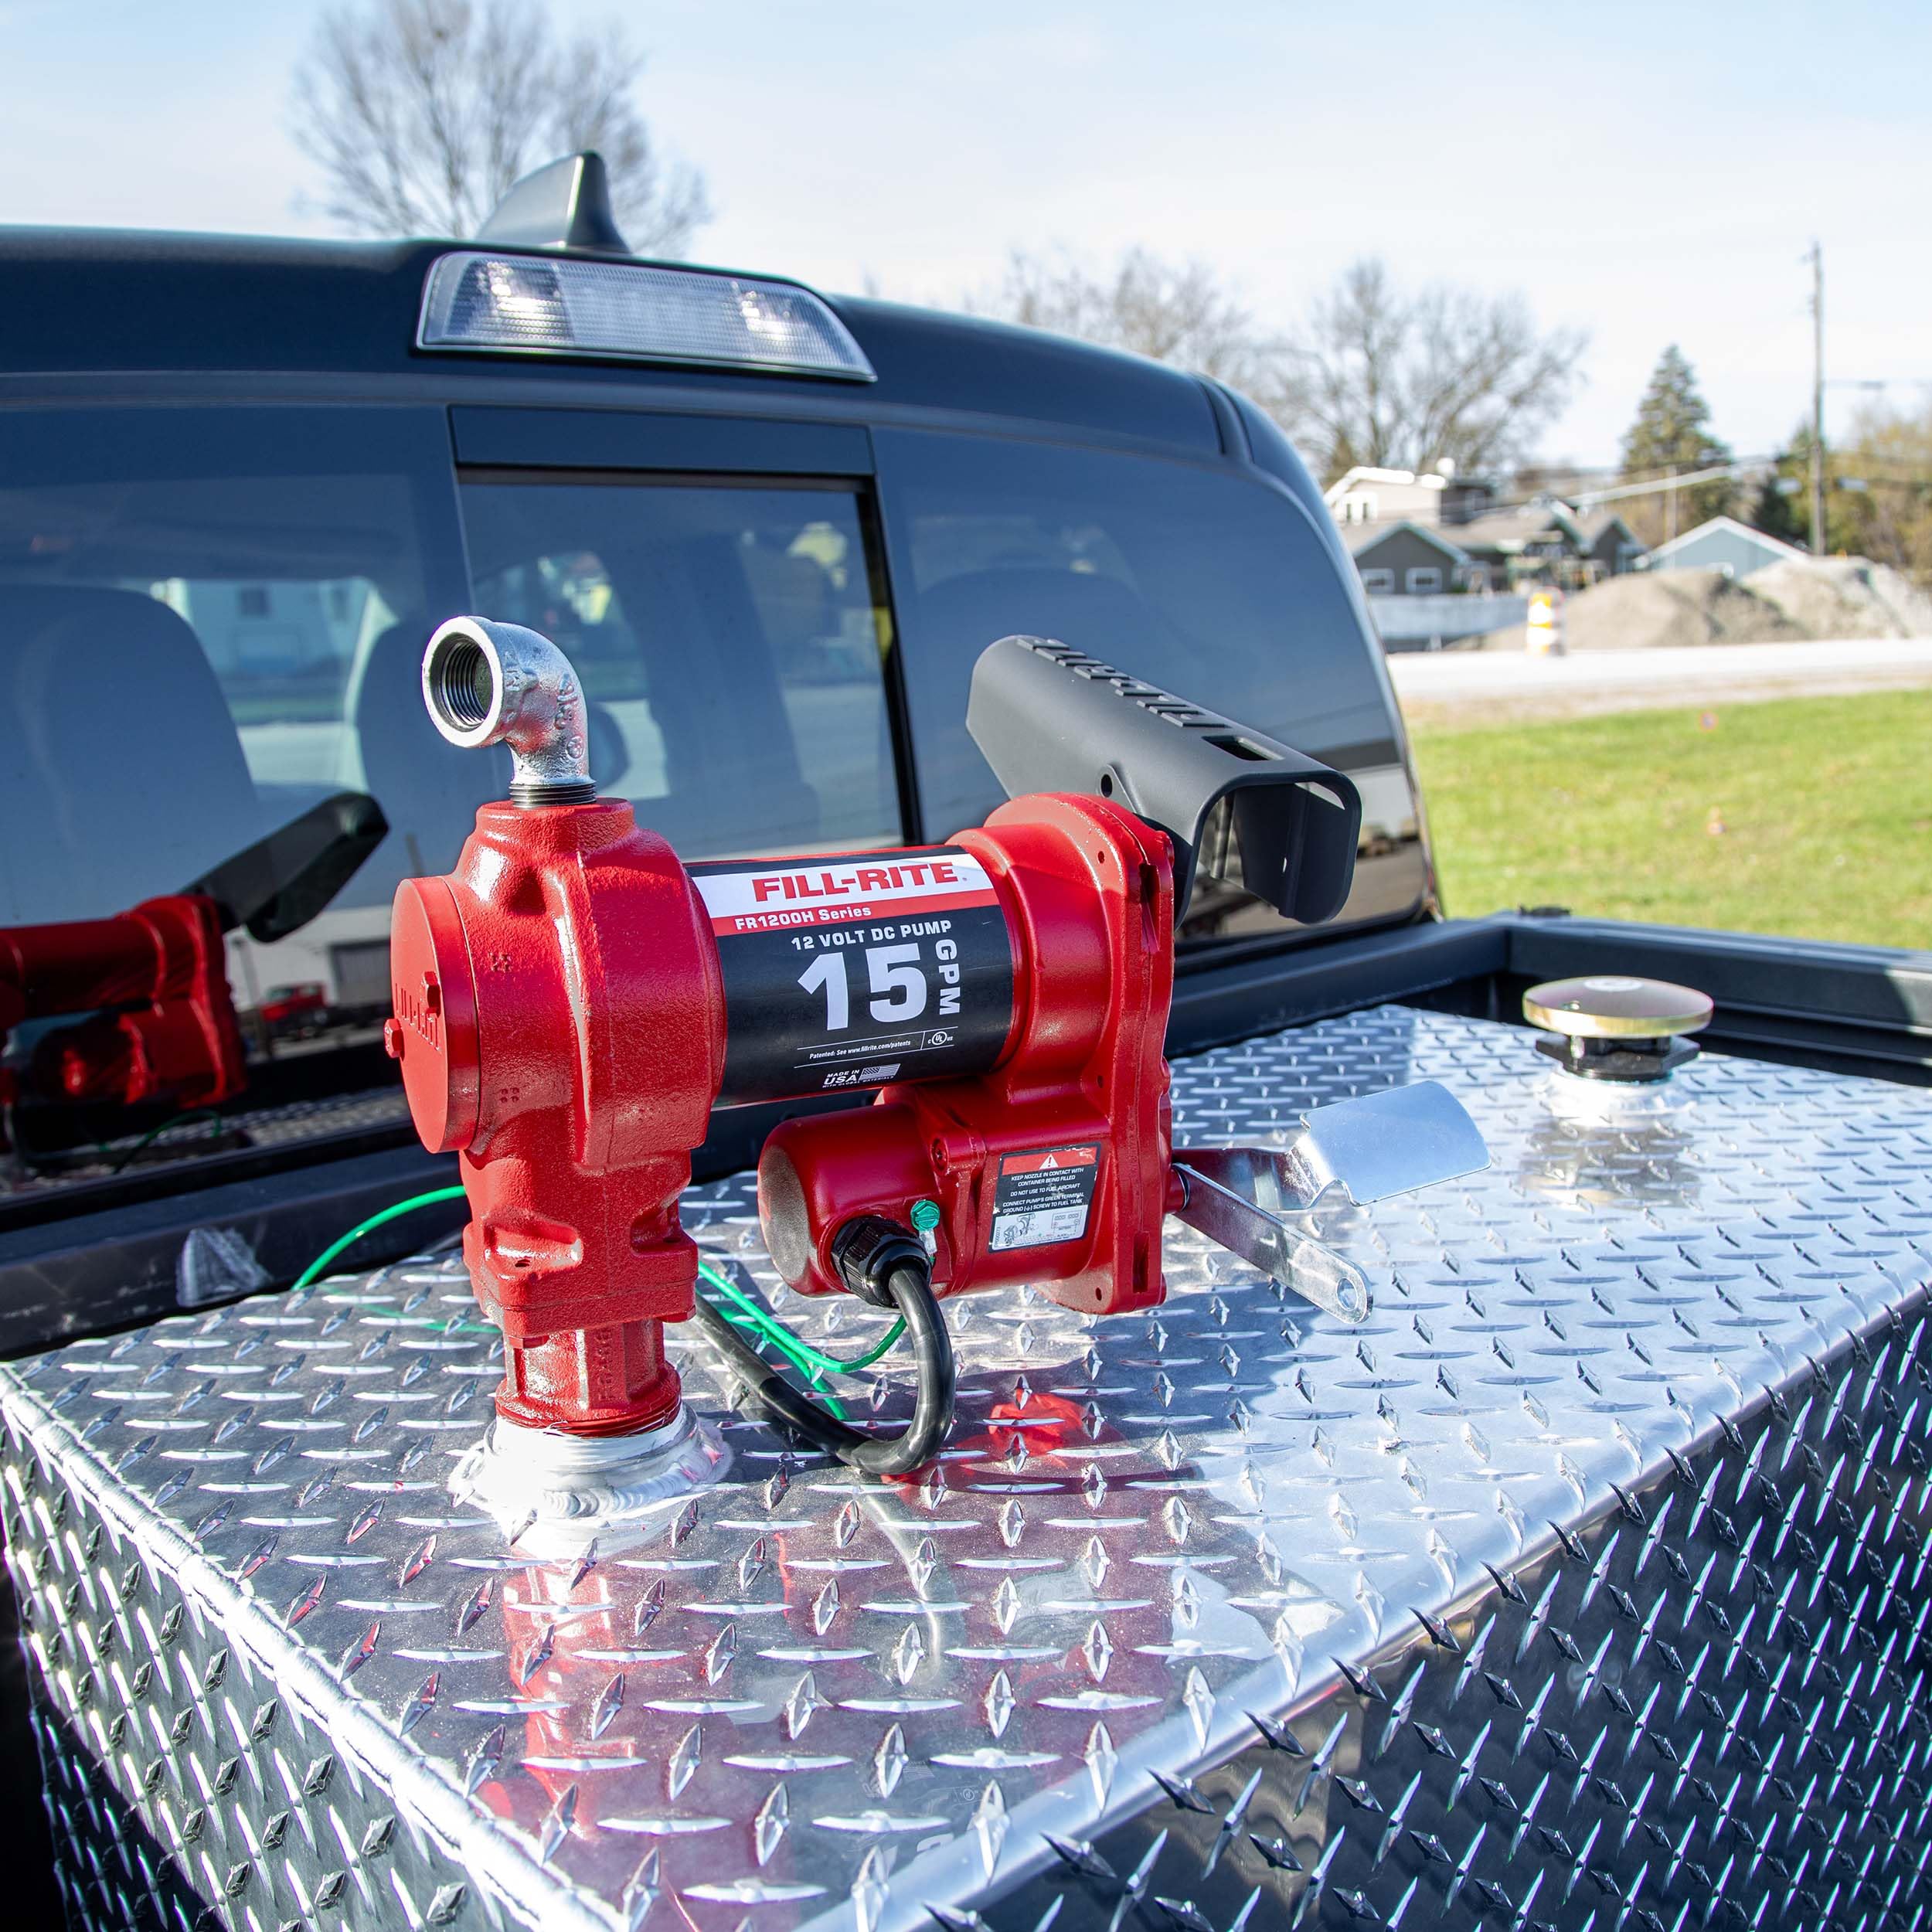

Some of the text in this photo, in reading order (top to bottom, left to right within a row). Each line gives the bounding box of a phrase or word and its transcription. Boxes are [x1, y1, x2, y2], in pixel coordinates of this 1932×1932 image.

[752, 862, 959, 903] FILL-RITE
[735, 906, 872, 930] FR1200H Series
[791, 920, 952, 951] 12 VOLT DC PUMP
[798, 942, 927, 1032] 15
[936, 939, 961, 1016] GPM
[809, 1050, 835, 1060] Patented:
[848, 1040, 911, 1054] www.fillrite.com/patents
[824, 1074, 857, 1085] USA
